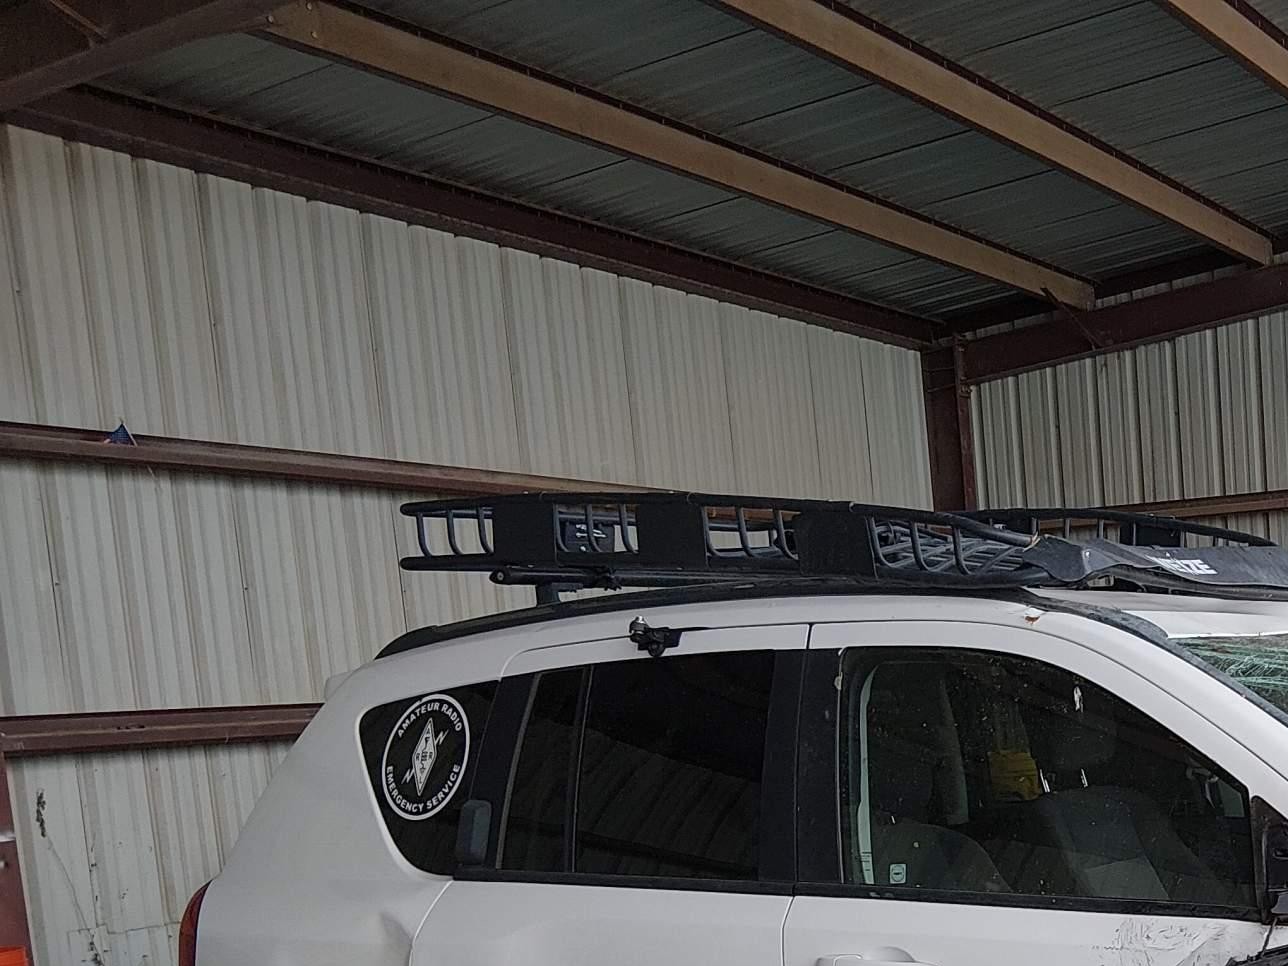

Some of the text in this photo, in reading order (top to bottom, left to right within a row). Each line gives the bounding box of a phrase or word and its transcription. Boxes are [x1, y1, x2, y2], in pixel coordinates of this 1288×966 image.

[397, 702, 462, 738] AMATEUR RADIO
[386, 764, 460, 812] EMERGENCY SERVICE
